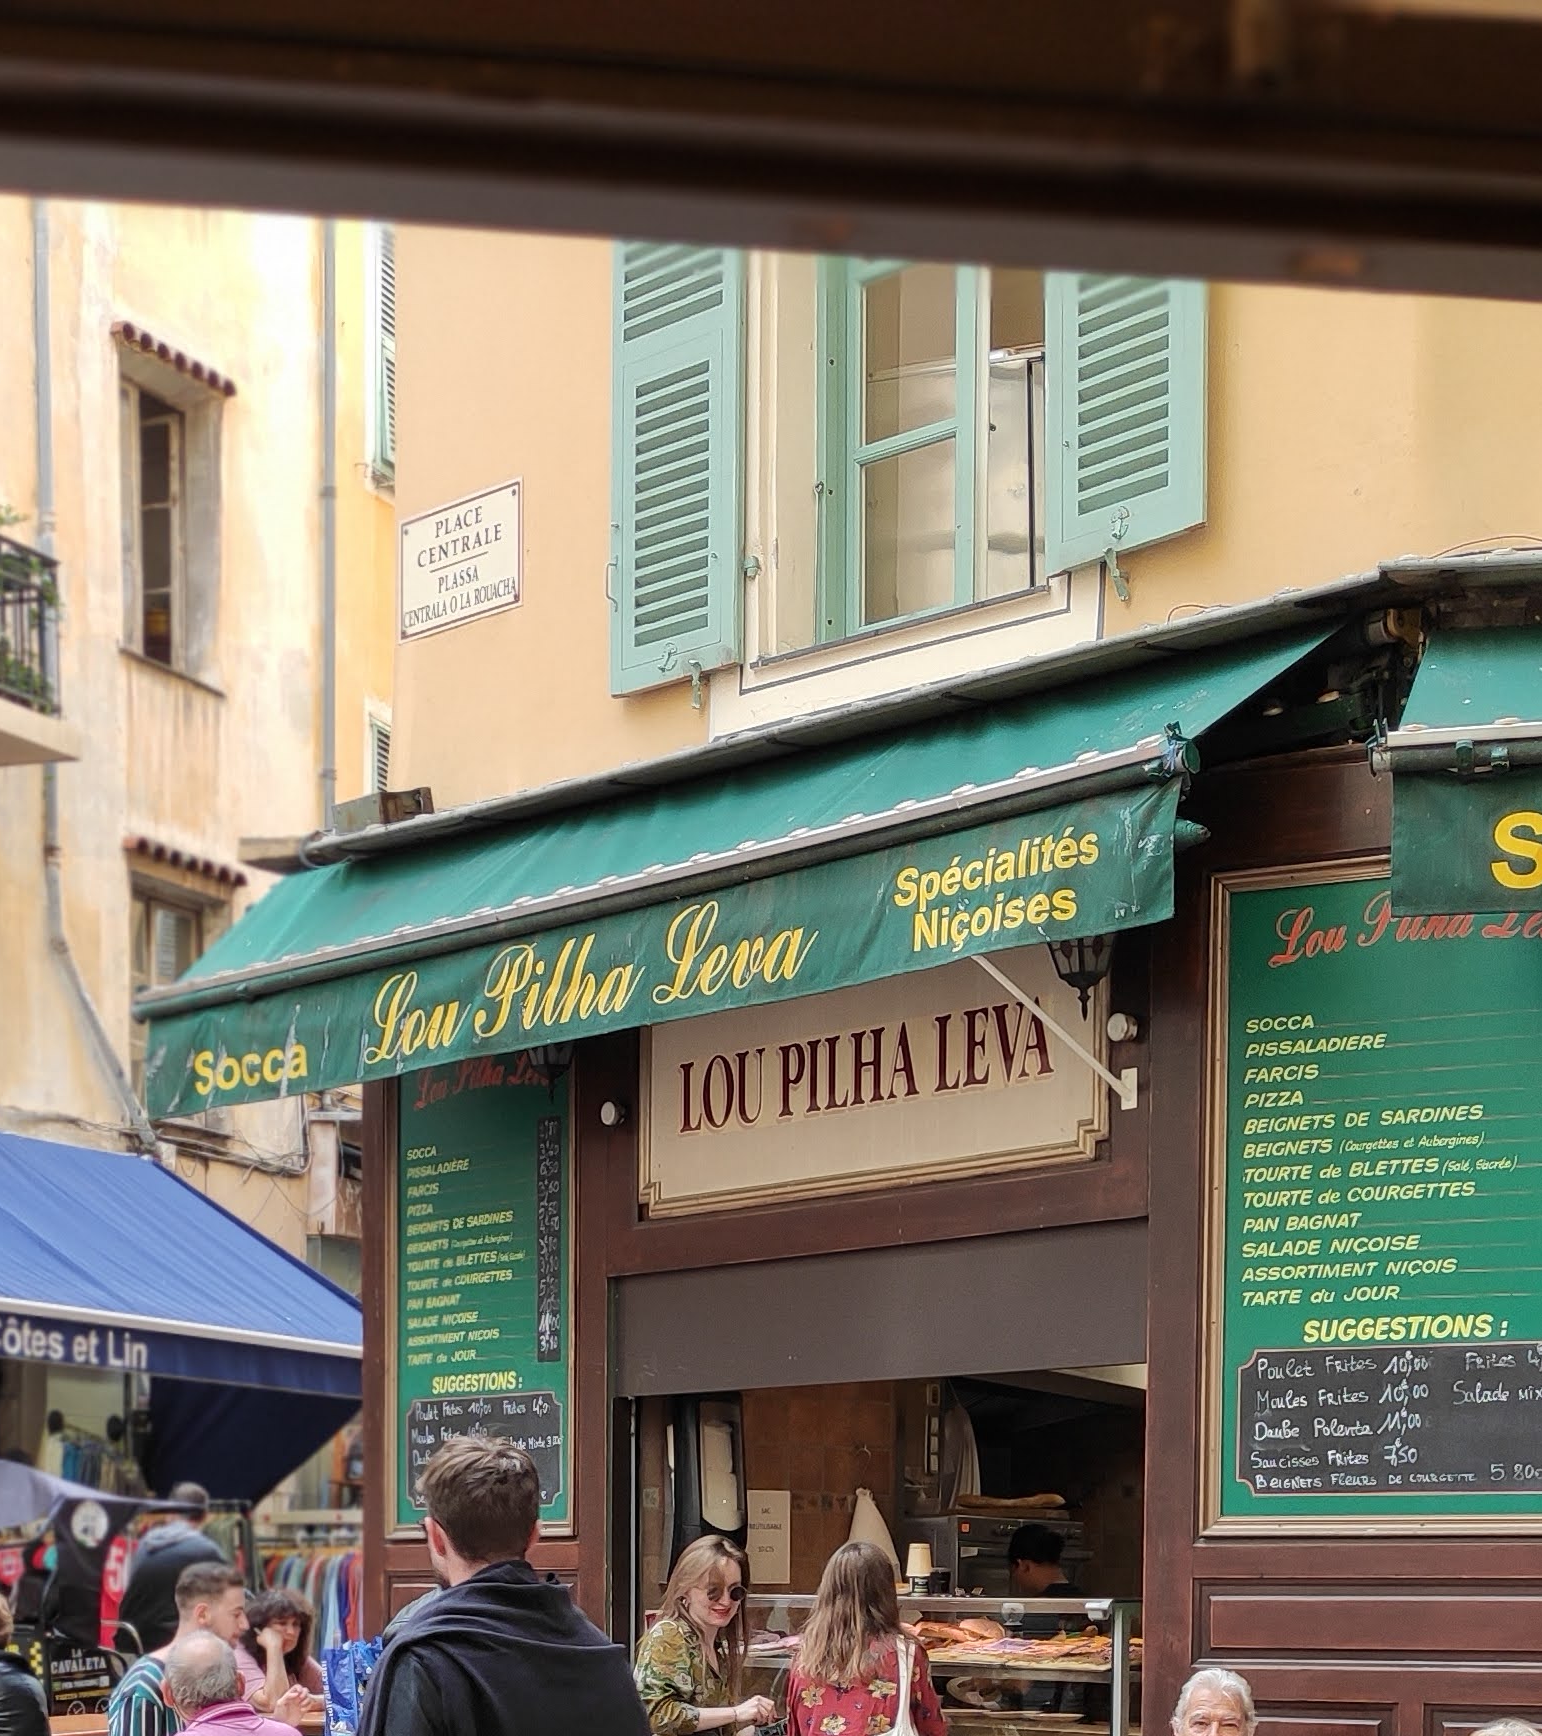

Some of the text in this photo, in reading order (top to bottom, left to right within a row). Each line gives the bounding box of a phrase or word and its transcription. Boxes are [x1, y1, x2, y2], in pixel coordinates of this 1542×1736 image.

[435, 505, 483, 539] PLACE
[417, 523, 502, 568] CENTRALE
[438, 564, 479, 594] PLASSA
[403, 576, 517, 629] CENTRALA O LA ROUACHA
[893, 826, 1100, 912] Spécialités
[912, 888, 1078, 952] Niçoises
[1268, 906, 1348, 968] Lou
[194, 901, 819, 1096] Socca Lou Pilha Leva
[1245, 1014, 1315, 1034] SOCCA
[1245, 1033, 1388, 1059] PISSALADIERE
[679, 996, 1055, 1134] LOU PILHA LEVA
[1244, 1064, 1320, 1085] FARCIS
[1244, 1090, 1304, 1109] PIZZA
[1243, 1104, 1484, 1135] BEIGNETS DE SARDINES
[406, 1145, 437, 1161] SOCCA
[1243, 1138, 1333, 1160] BEIGNETS
[1339, 1137, 1399, 1155] (Courgettes
[1404, 1135, 1414, 1148] et
[1243, 1165, 1313, 1184] TOURTE
[1319, 1163, 1341, 1179] de
[1349, 1157, 1439, 1178] BLETTES
[407, 1183, 440, 1199] FARCIS
[1243, 1181, 1476, 1209] TOURTE de COURGETTES
[407, 1203, 434, 1218] PIZZA
[406, 1210, 514, 1237] BEIGNETS DE SARDINES
[1243, 1212, 1362, 1234] PAN BAGNAT
[406, 1238, 449, 1255] BEIGNETS
[1242, 1234, 1421, 1258] SALADE NIÇOISE
[406, 1258, 440, 1273] TOURTE
[443, 1258, 454, 1268] de
[455, 1251, 497, 1267] BLETTES
[1241, 1258, 1458, 1283] ASSORTIMENT NIÇOIS
[406, 1269, 513, 1292] TOURTE de COURGETTES
[406, 1293, 461, 1311] PAN BAGNAT
[1242, 1285, 1400, 1307] TARTE du JOUR
[407, 1311, 479, 1330] SALADE NIÇOISE
[72, 1329, 99, 1364] et
[108, 1331, 148, 1369] Lin
[407, 1328, 500, 1347] ASSORTIMENT NIÇOIS
[407, 1349, 477, 1367] TARTE du JOUR
[1257, 1358, 1315, 1380] Poulet
[1256, 1389, 1308, 1411] Moules
[1452, 1380, 1510, 1405] Salade
[1253, 1419, 1300, 1441] Daube
[1313, 1417, 1374, 1438] Polenta
[1251, 1451, 1320, 1469] Saucisses
[50, 1656, 108, 1675] CAVALETA
